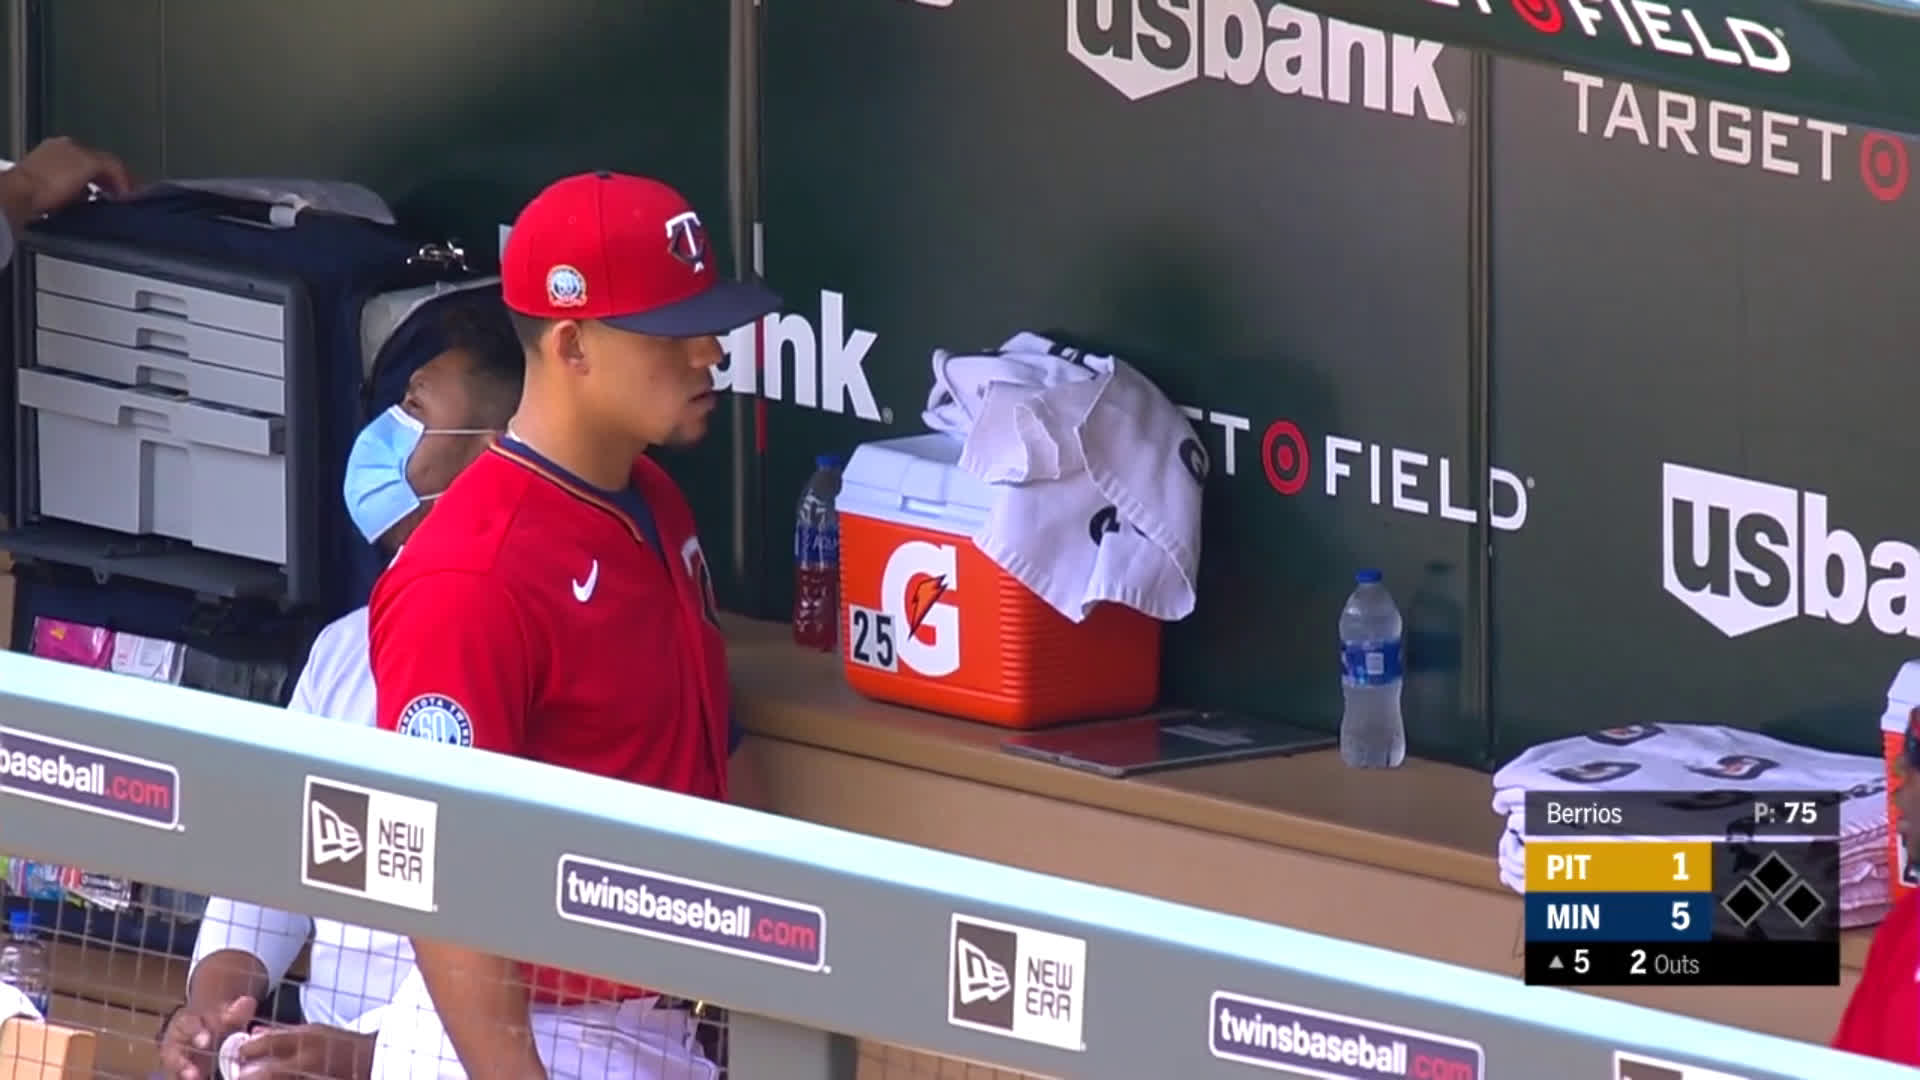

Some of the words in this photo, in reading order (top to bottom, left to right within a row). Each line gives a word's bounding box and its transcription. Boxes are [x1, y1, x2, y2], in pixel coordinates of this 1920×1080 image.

[1563, 70, 1849, 183] TARGET
[1325, 435, 1528, 531] FIELD
[881, 540, 961, 677] G
[852, 609, 895, 668] 25
[378, 817, 424, 854] NEW
[377, 848, 423, 884] ERA
[567, 870, 817, 952] twinsbaseball.com
[1026, 955, 1073, 992] NEW
[1025, 986, 1072, 1023] ERA
